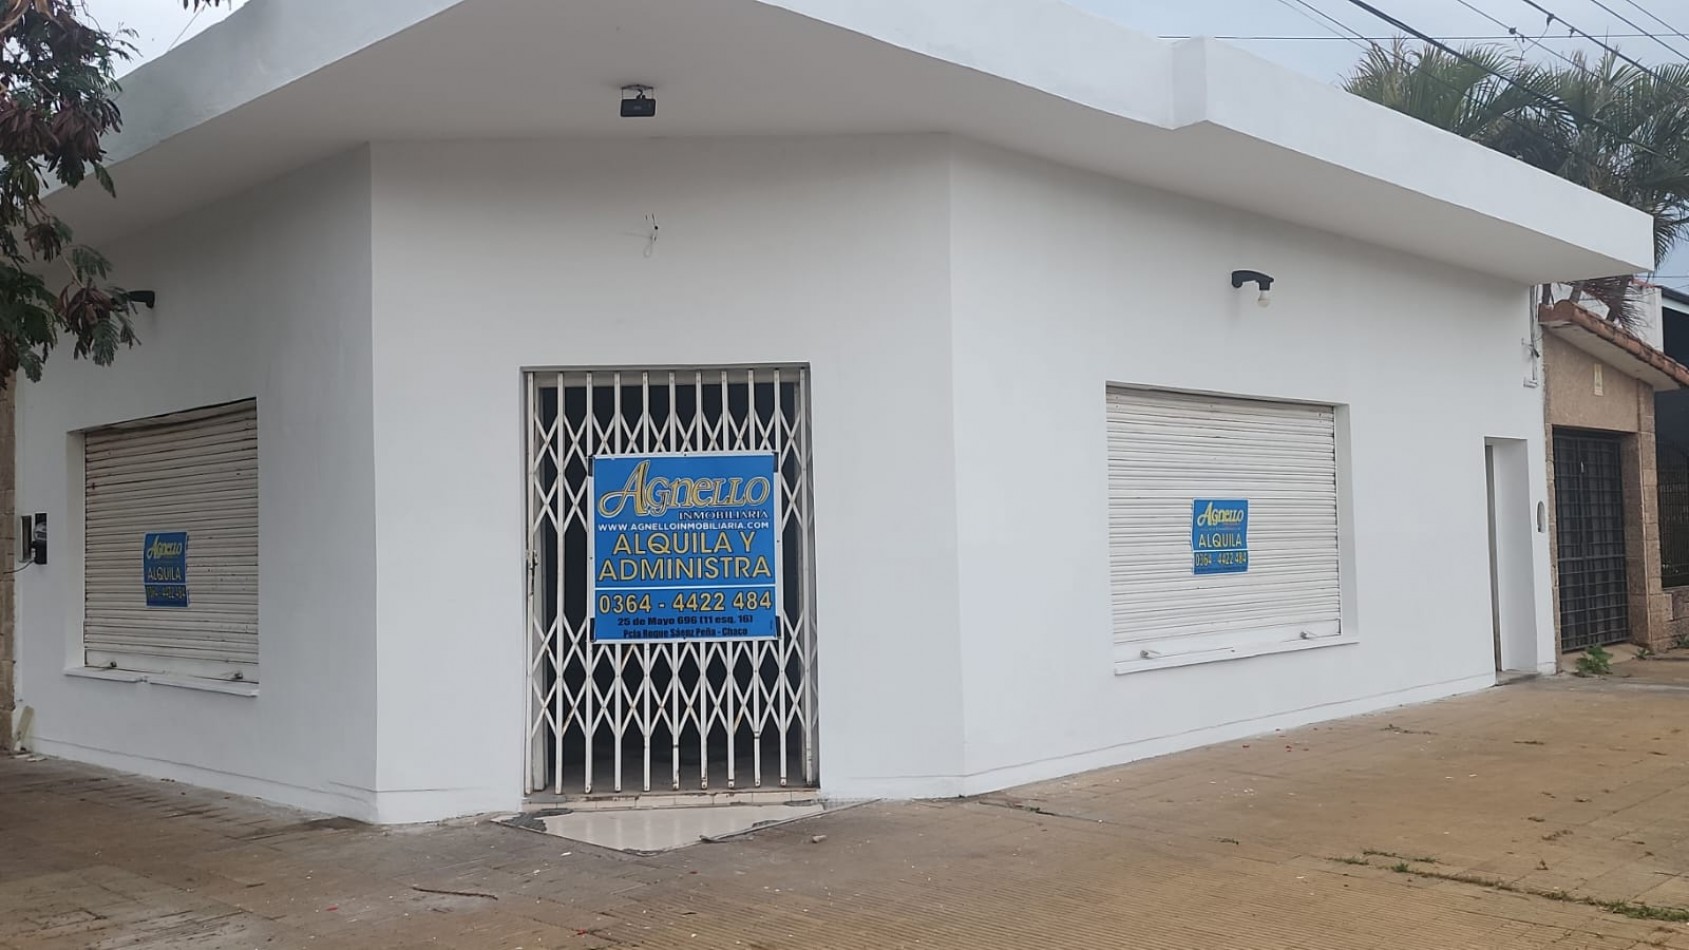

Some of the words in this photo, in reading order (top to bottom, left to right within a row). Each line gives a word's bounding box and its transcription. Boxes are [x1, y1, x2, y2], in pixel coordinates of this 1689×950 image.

[679, 510, 769, 521] INMOBILIARIA
[598, 521, 770, 532] WWW.AGNELLOINMOBILIARIA.COM
[613, 531, 732, 555] ALQUILA
[740, 531, 756, 553] Y
[1198, 533, 1242, 548] ALQUILA
[148, 566, 182, 581] ALQUILA
[598, 556, 772, 582] ADMINISTRA
[599, 594, 651, 614] 0364
[672, 592, 725, 613] 4422
[733, 590, 772, 611] 484
[617, 617, 631, 626] 25
[632, 617, 646, 626] de
[647, 617, 675, 626] Mayo
[677, 615, 697, 625] 696
[642, 629, 669, 639] Roque
[696, 627, 716, 638] Peña
[722, 627, 748, 637] Chaco
